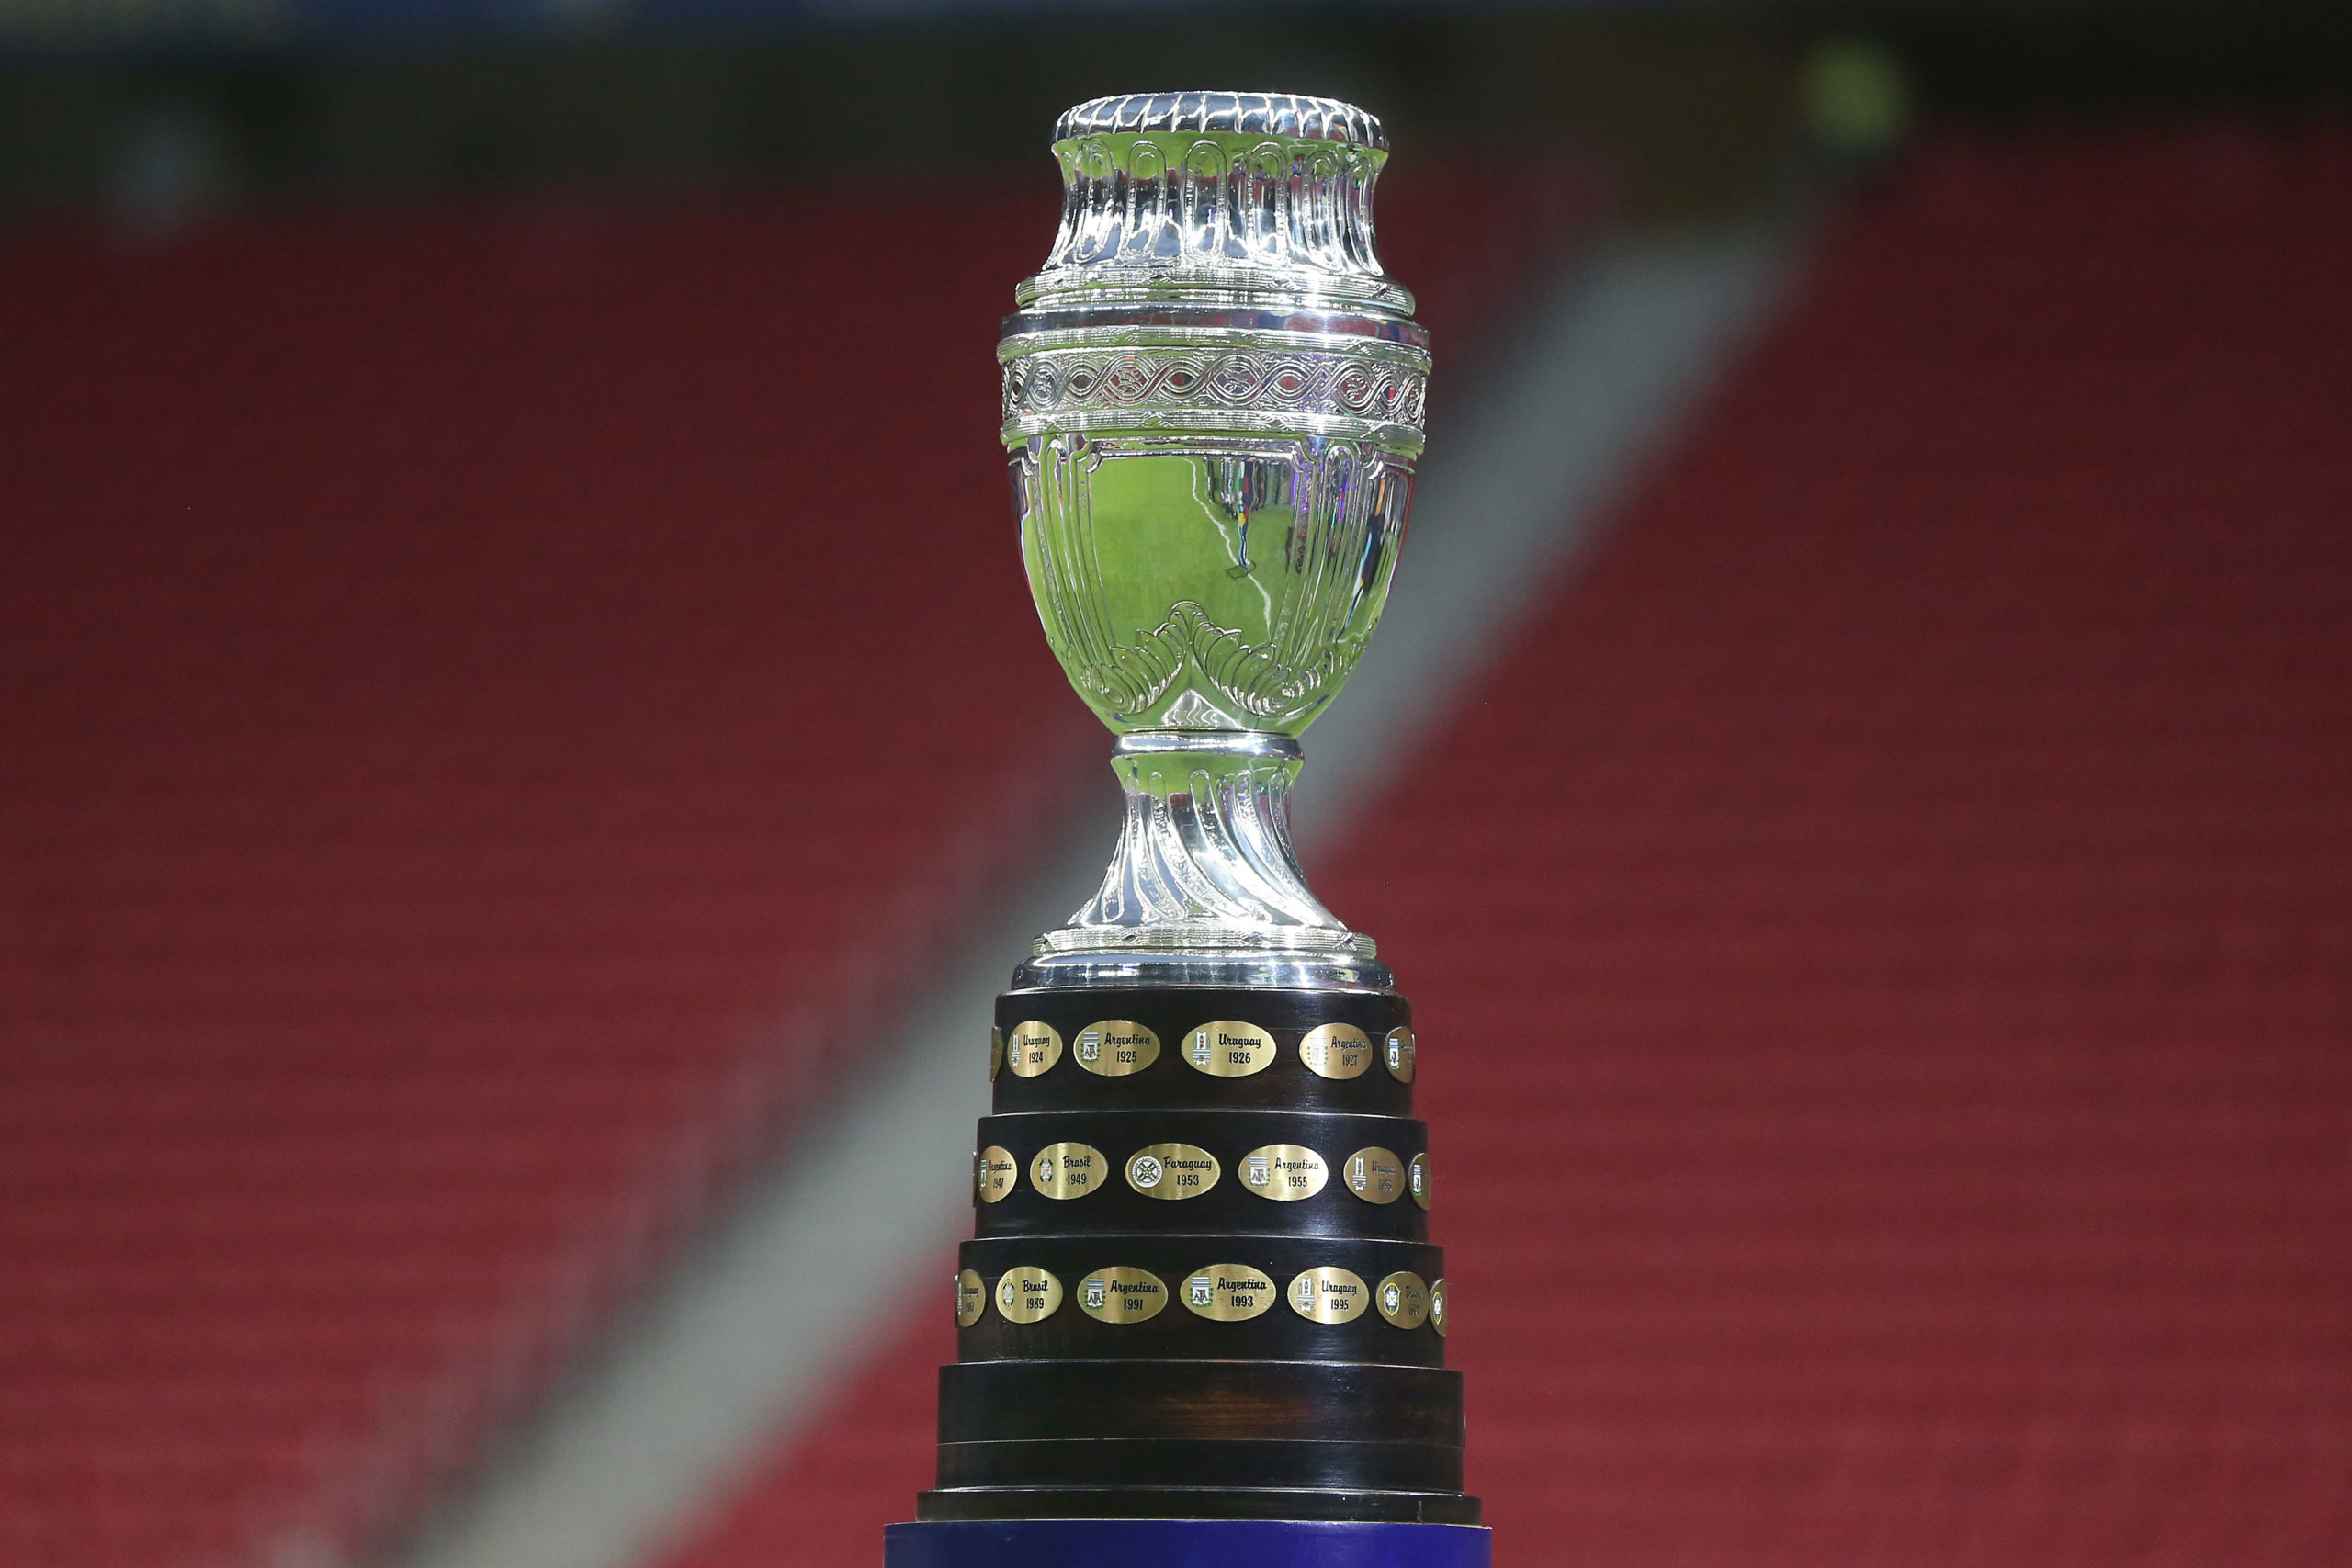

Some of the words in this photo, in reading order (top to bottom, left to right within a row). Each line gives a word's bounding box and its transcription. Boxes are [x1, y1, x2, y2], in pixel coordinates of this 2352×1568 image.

[1023, 1034, 1051, 1047] Uruguay
[1104, 1032, 1152, 1048] Argentina
[1218, 1033, 1261, 1049] Uruguay
[1330, 1036, 1368, 1051] Argentina
[1028, 1052, 1044, 1063] 1924
[1116, 1051, 1137, 1063] 1925
[1228, 1052, 1251, 1064] 1926
[1342, 1054, 1359, 1066] 1927
[1062, 1155, 1091, 1168] Brasil
[1163, 1156, 1213, 1171] Paraguay
[1274, 1157, 1320, 1172] Argentina
[1067, 1174, 1087, 1186] 1949
[1176, 1175, 1200, 1187] 1953
[1288, 1176, 1308, 1188] 1955
[1023, 1280, 1049, 1292] Brasil
[1110, 1280, 1159, 1294] Argentina
[1216, 1277, 1268, 1292] Argentina
[1321, 1280, 1358, 1296] Uruguay
[1026, 1297, 1045, 1310] 1989
[1124, 1298, 1143, 1311] 1991
[1231, 1296, 1254, 1308] 1993
[1330, 1299, 1349, 1311] 1995
